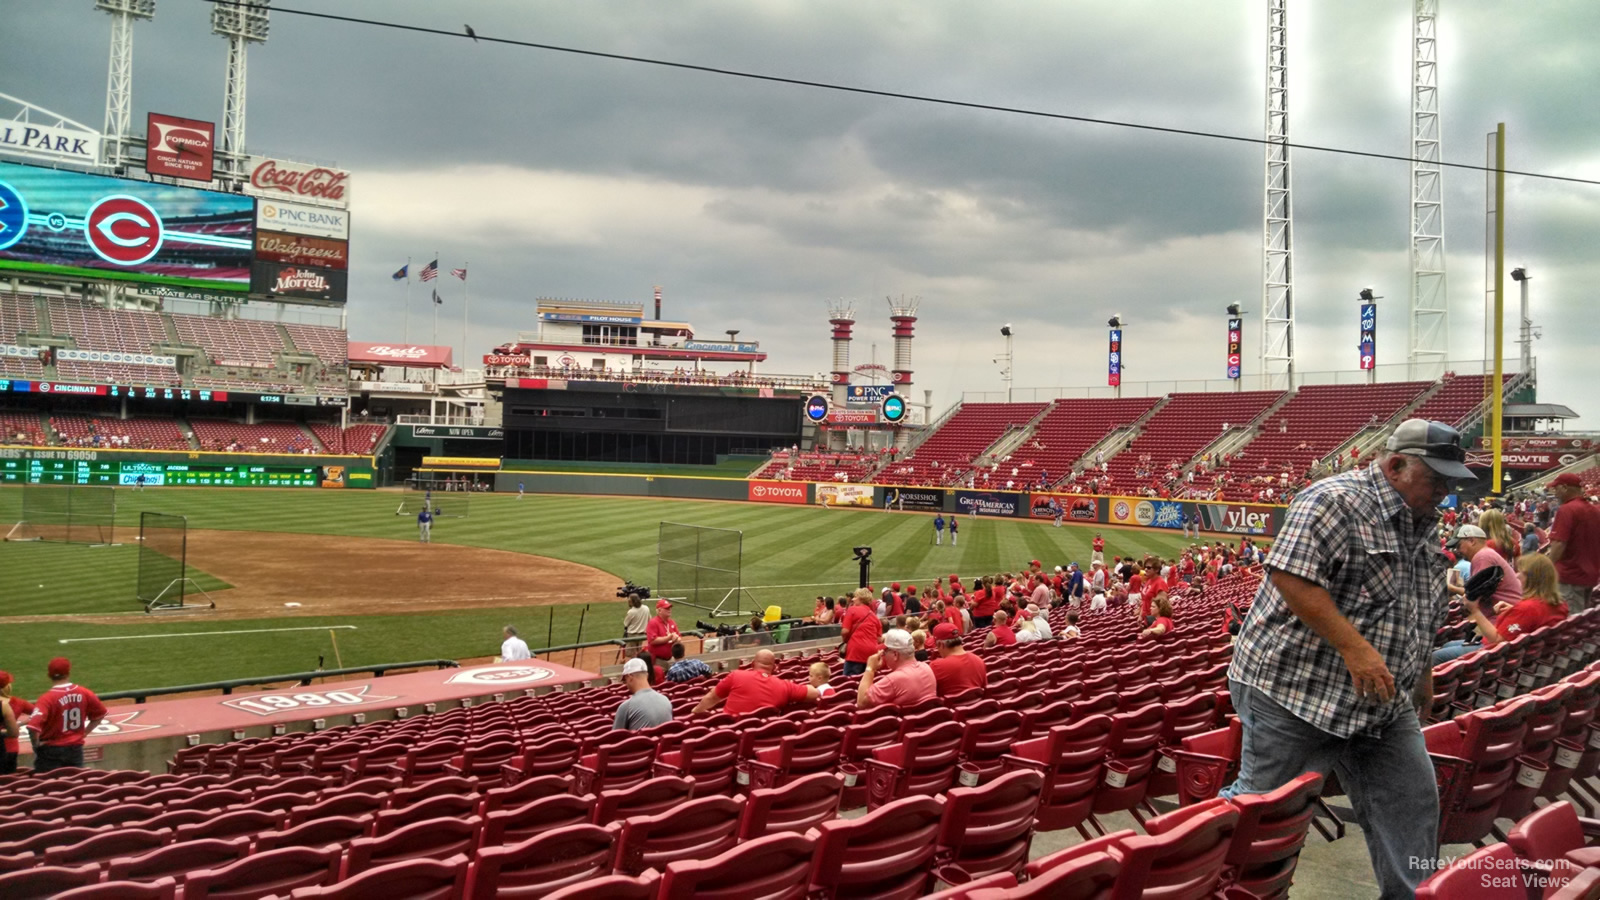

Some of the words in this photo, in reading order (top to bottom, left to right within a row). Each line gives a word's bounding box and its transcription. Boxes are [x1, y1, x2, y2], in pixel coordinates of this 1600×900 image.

[0, 128, 18, 144] L
[21, 127, 91, 155] PARK
[166, 136, 208, 147] FORMICA
[251, 160, 348, 199] Coca-Cola
[51, 218, 63, 226] VS
[279, 208, 306, 222] PNC
[309, 213, 342, 226] BANK
[260, 237, 343, 259] Walgreens
[293, 269, 316, 279] John
[271, 276, 330, 292] Morrell
[140, 288, 185, 298] ULTIMATE
[203, 294, 246, 303] SHUTTLE
[366, 345, 428, 357] Reds
[685, 342, 735, 351] Cincinnati
[738, 344, 756, 352] Bell
[500, 356, 531, 364] TOYOTA
[54, 385, 97, 393] CINCINNATI
[864, 387, 885, 396] PNC
[33, 451, 55, 459] ISSUE
[67, 451, 97, 460] 69050
[1501, 455, 1550, 463] BOWTIE
[767, 487, 803, 497] TOYOTA
[960, 496, 982, 505] GREAT
[981, 500, 1015, 510] AMERICAN
[1196, 504, 1270, 532] Wyler
[59, 694, 82, 706] VOTTO
[238, 690, 364, 712] 1990
[62, 707, 81, 732] 19
